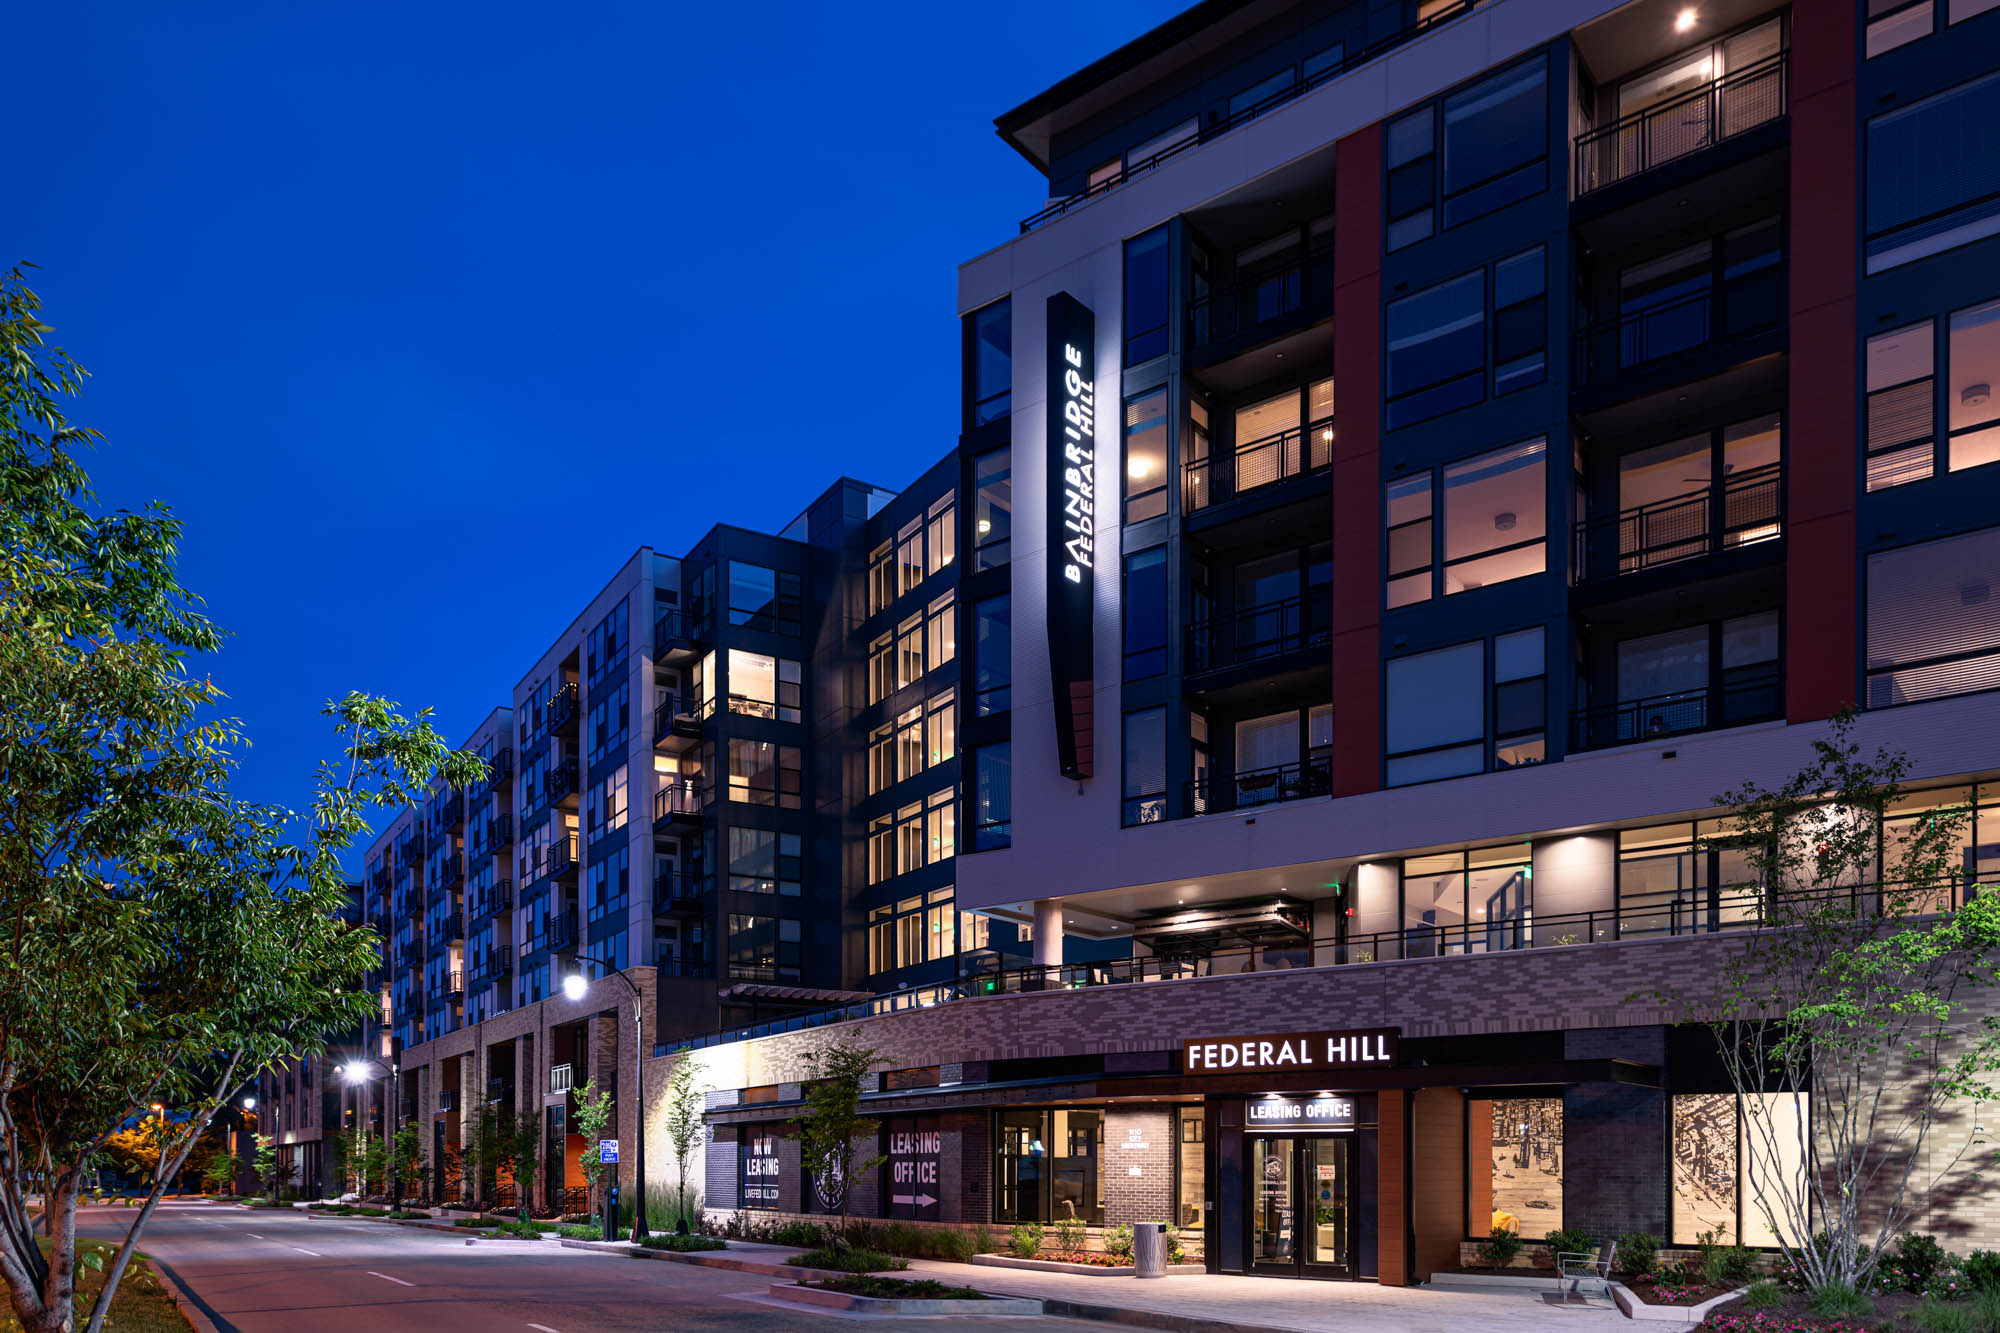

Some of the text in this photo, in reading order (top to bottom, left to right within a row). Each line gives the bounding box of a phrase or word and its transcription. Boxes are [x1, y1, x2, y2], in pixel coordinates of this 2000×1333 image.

[1065, 343, 1082, 584] BAINBRIDGE
[1080, 381, 1093, 568] FEDERAL HILL
[1189, 1035, 1391, 1069] FEDERAL HILL
[1250, 1103, 1351, 1120] LEASING OFFICE
[753, 1137, 772, 1156] NOW
[890, 1131, 941, 1154] LEASING
[746, 1158, 779, 1176] LEASING
[894, 1161, 937, 1184] OFFICE
